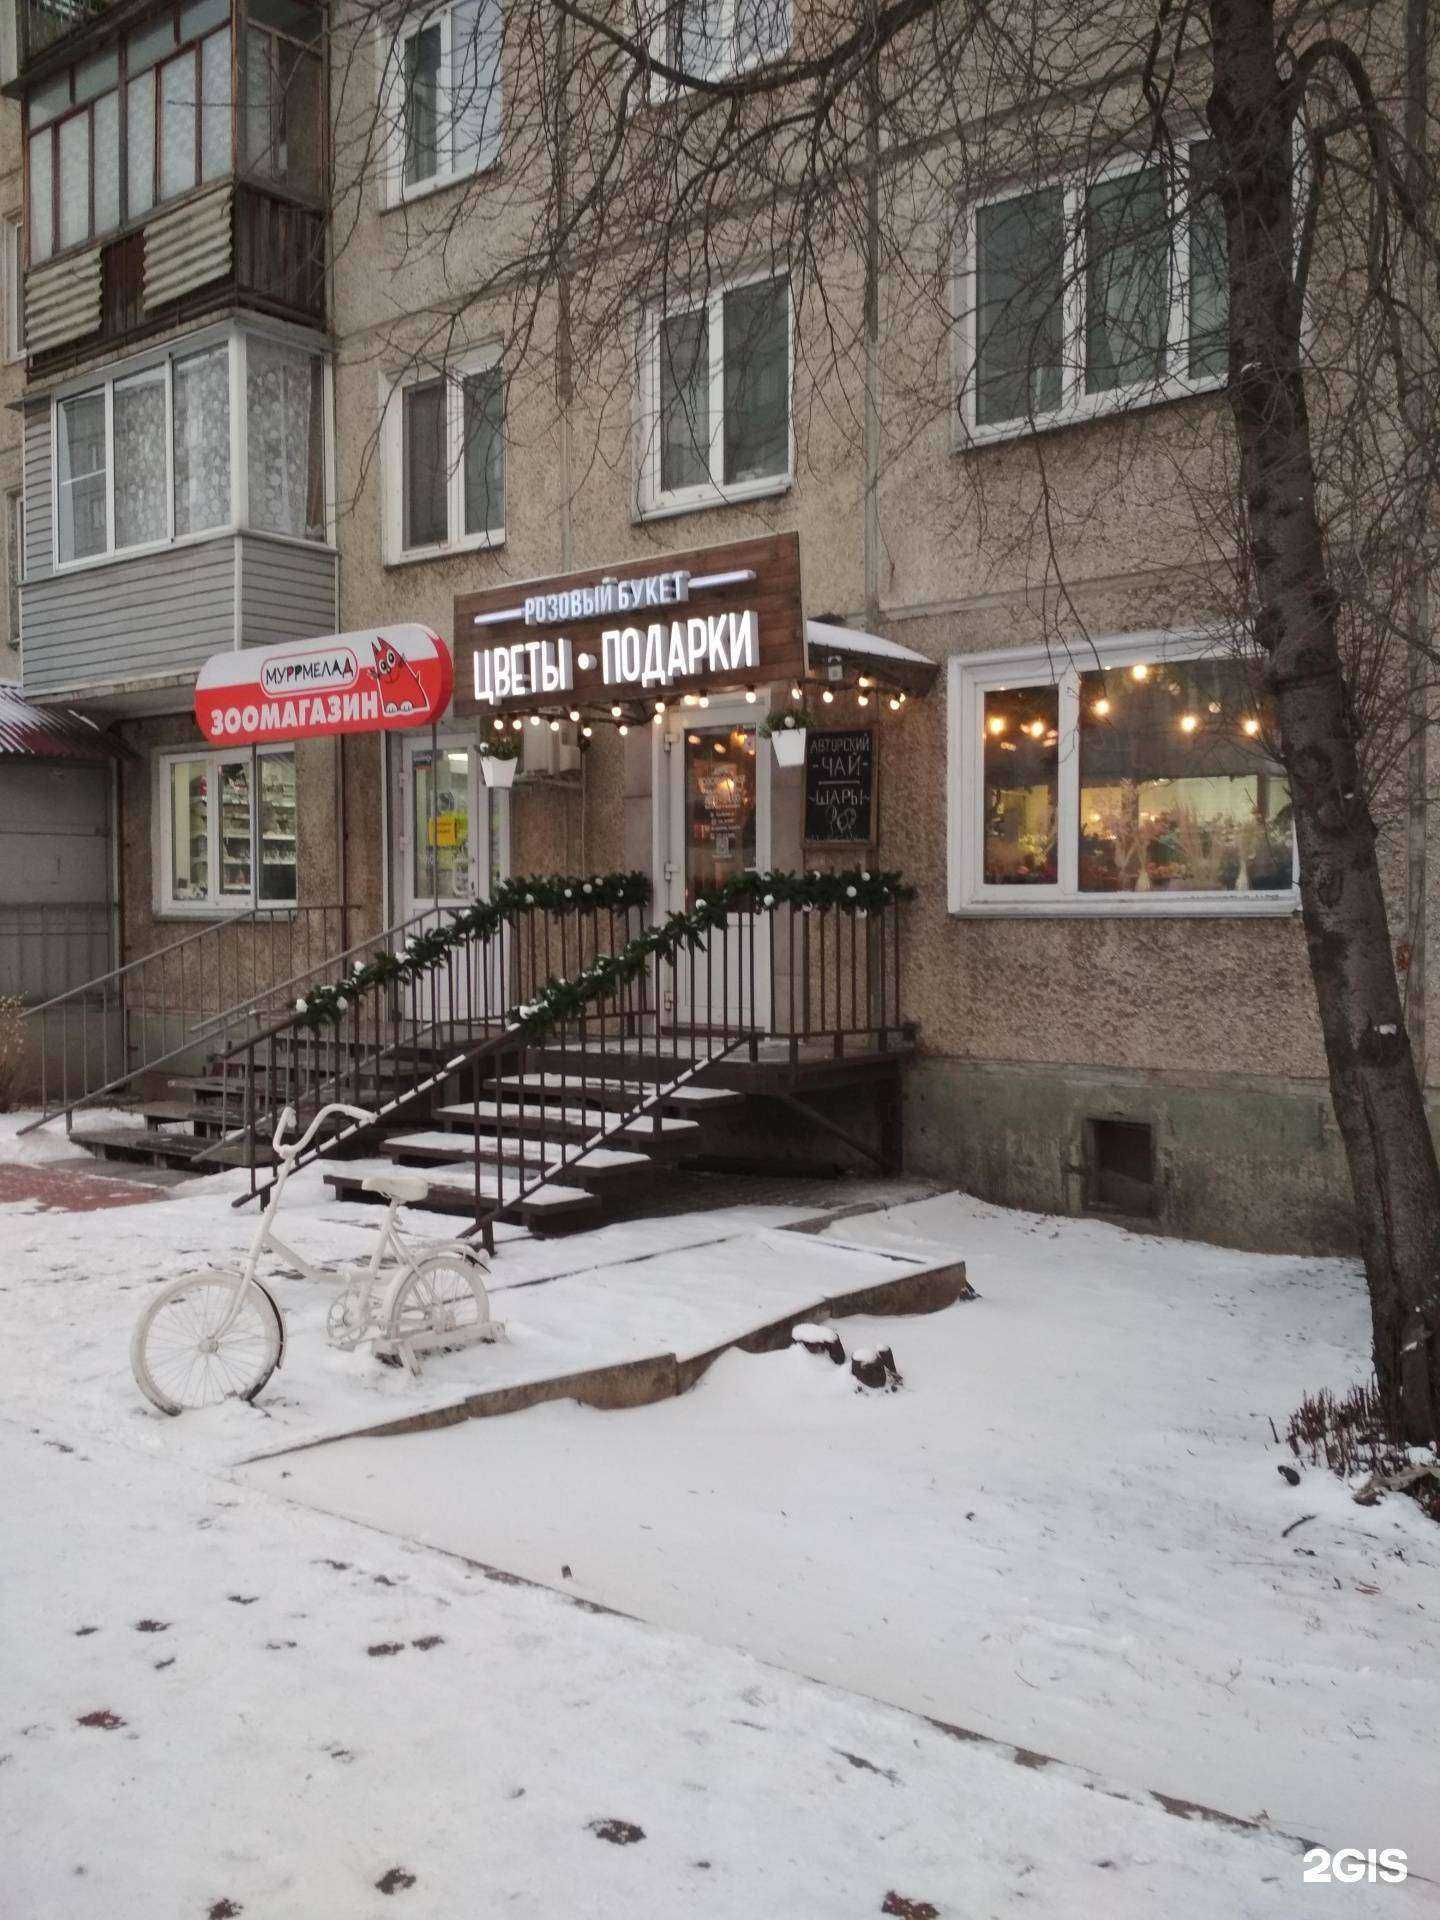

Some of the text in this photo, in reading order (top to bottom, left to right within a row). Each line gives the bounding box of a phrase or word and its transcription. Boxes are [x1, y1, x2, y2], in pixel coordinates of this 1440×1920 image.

[525, 570, 690, 625] РОЗОВЫЙ БУКЕТ
[265, 657, 354, 685] МУРРМЕЛАД
[473, 610, 759, 705] ЦВЕТЫ ПОДАРКИ
[210, 691, 379, 736] ЗООМАГАЗИН
